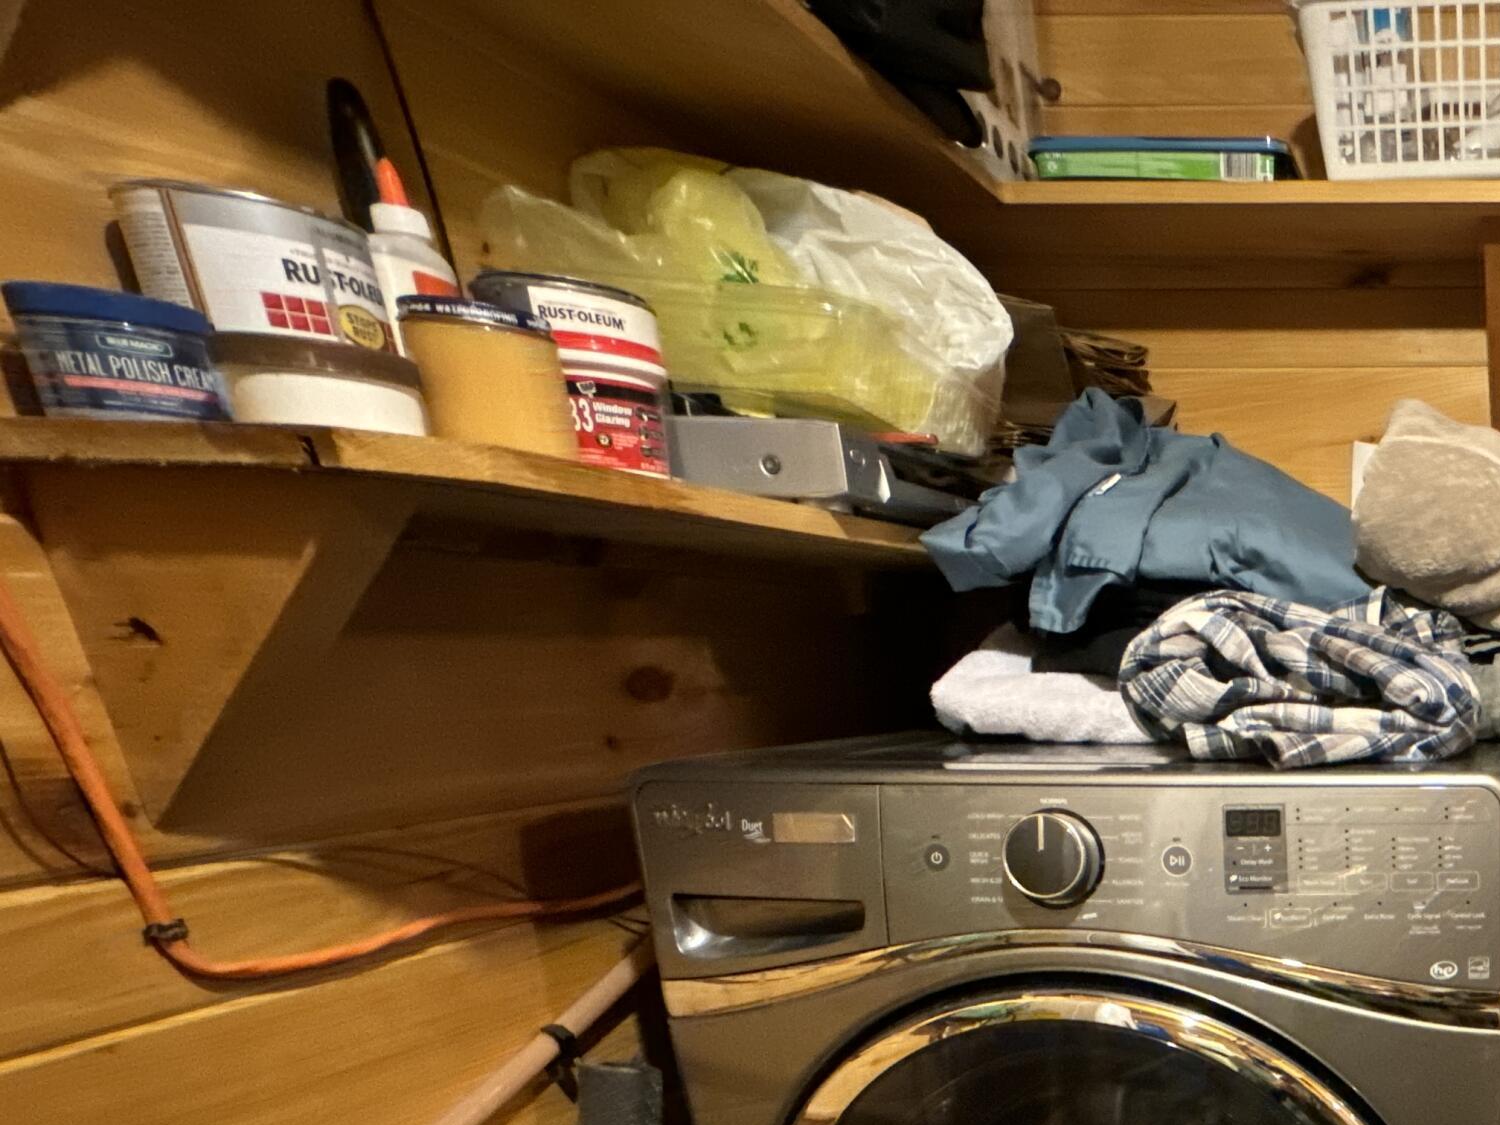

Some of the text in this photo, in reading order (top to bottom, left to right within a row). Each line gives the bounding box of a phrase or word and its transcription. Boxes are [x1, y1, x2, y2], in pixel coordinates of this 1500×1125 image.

[538, 304, 625, 331] RUST-OLEUM
[55, 351, 104, 377] METAL
[108, 355, 174, 385] POLISH
[592, 401, 633, 416] Window
[595, 413, 632, 428] Glazing
[742, 818, 763, 832] Duet
